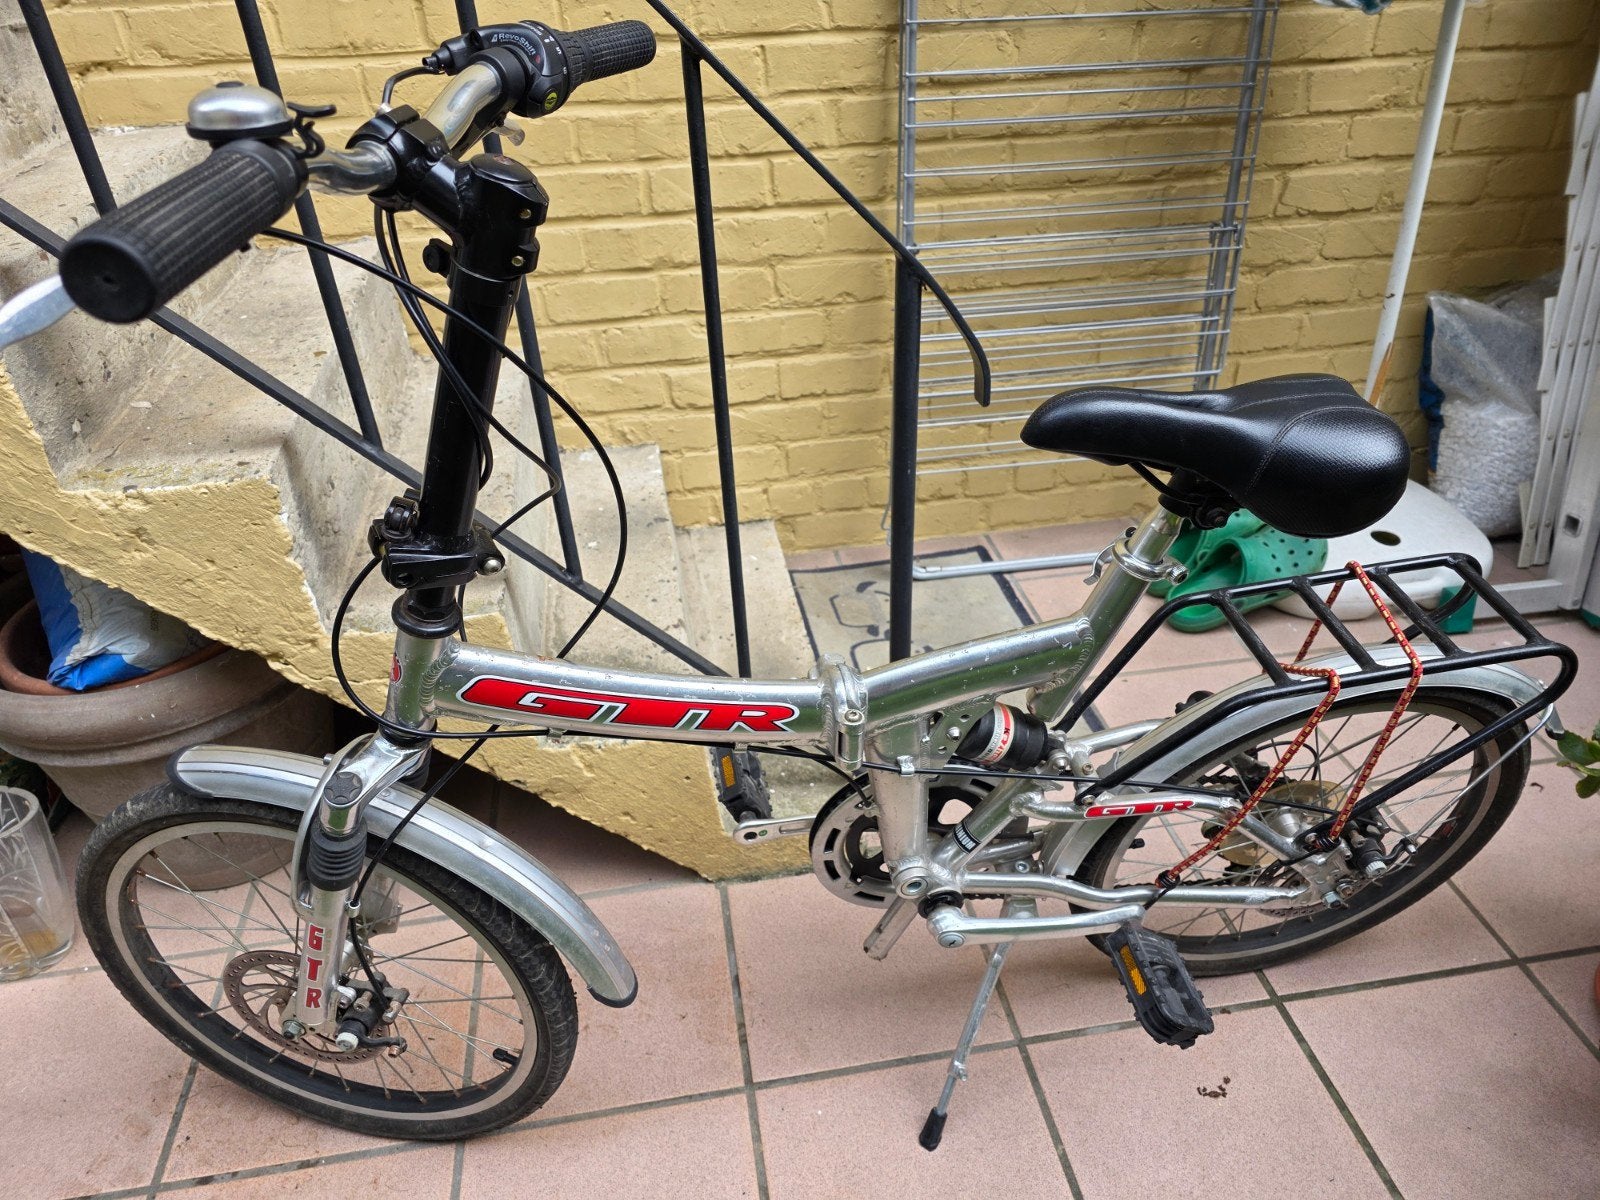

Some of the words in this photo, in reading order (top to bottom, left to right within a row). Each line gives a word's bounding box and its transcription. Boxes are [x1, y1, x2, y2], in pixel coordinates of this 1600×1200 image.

[498, 33, 537, 56] RevoShift
[456, 675, 800, 733] GTR
[1084, 801, 1195, 819] GTR
[305, 923, 325, 1009] GTR
